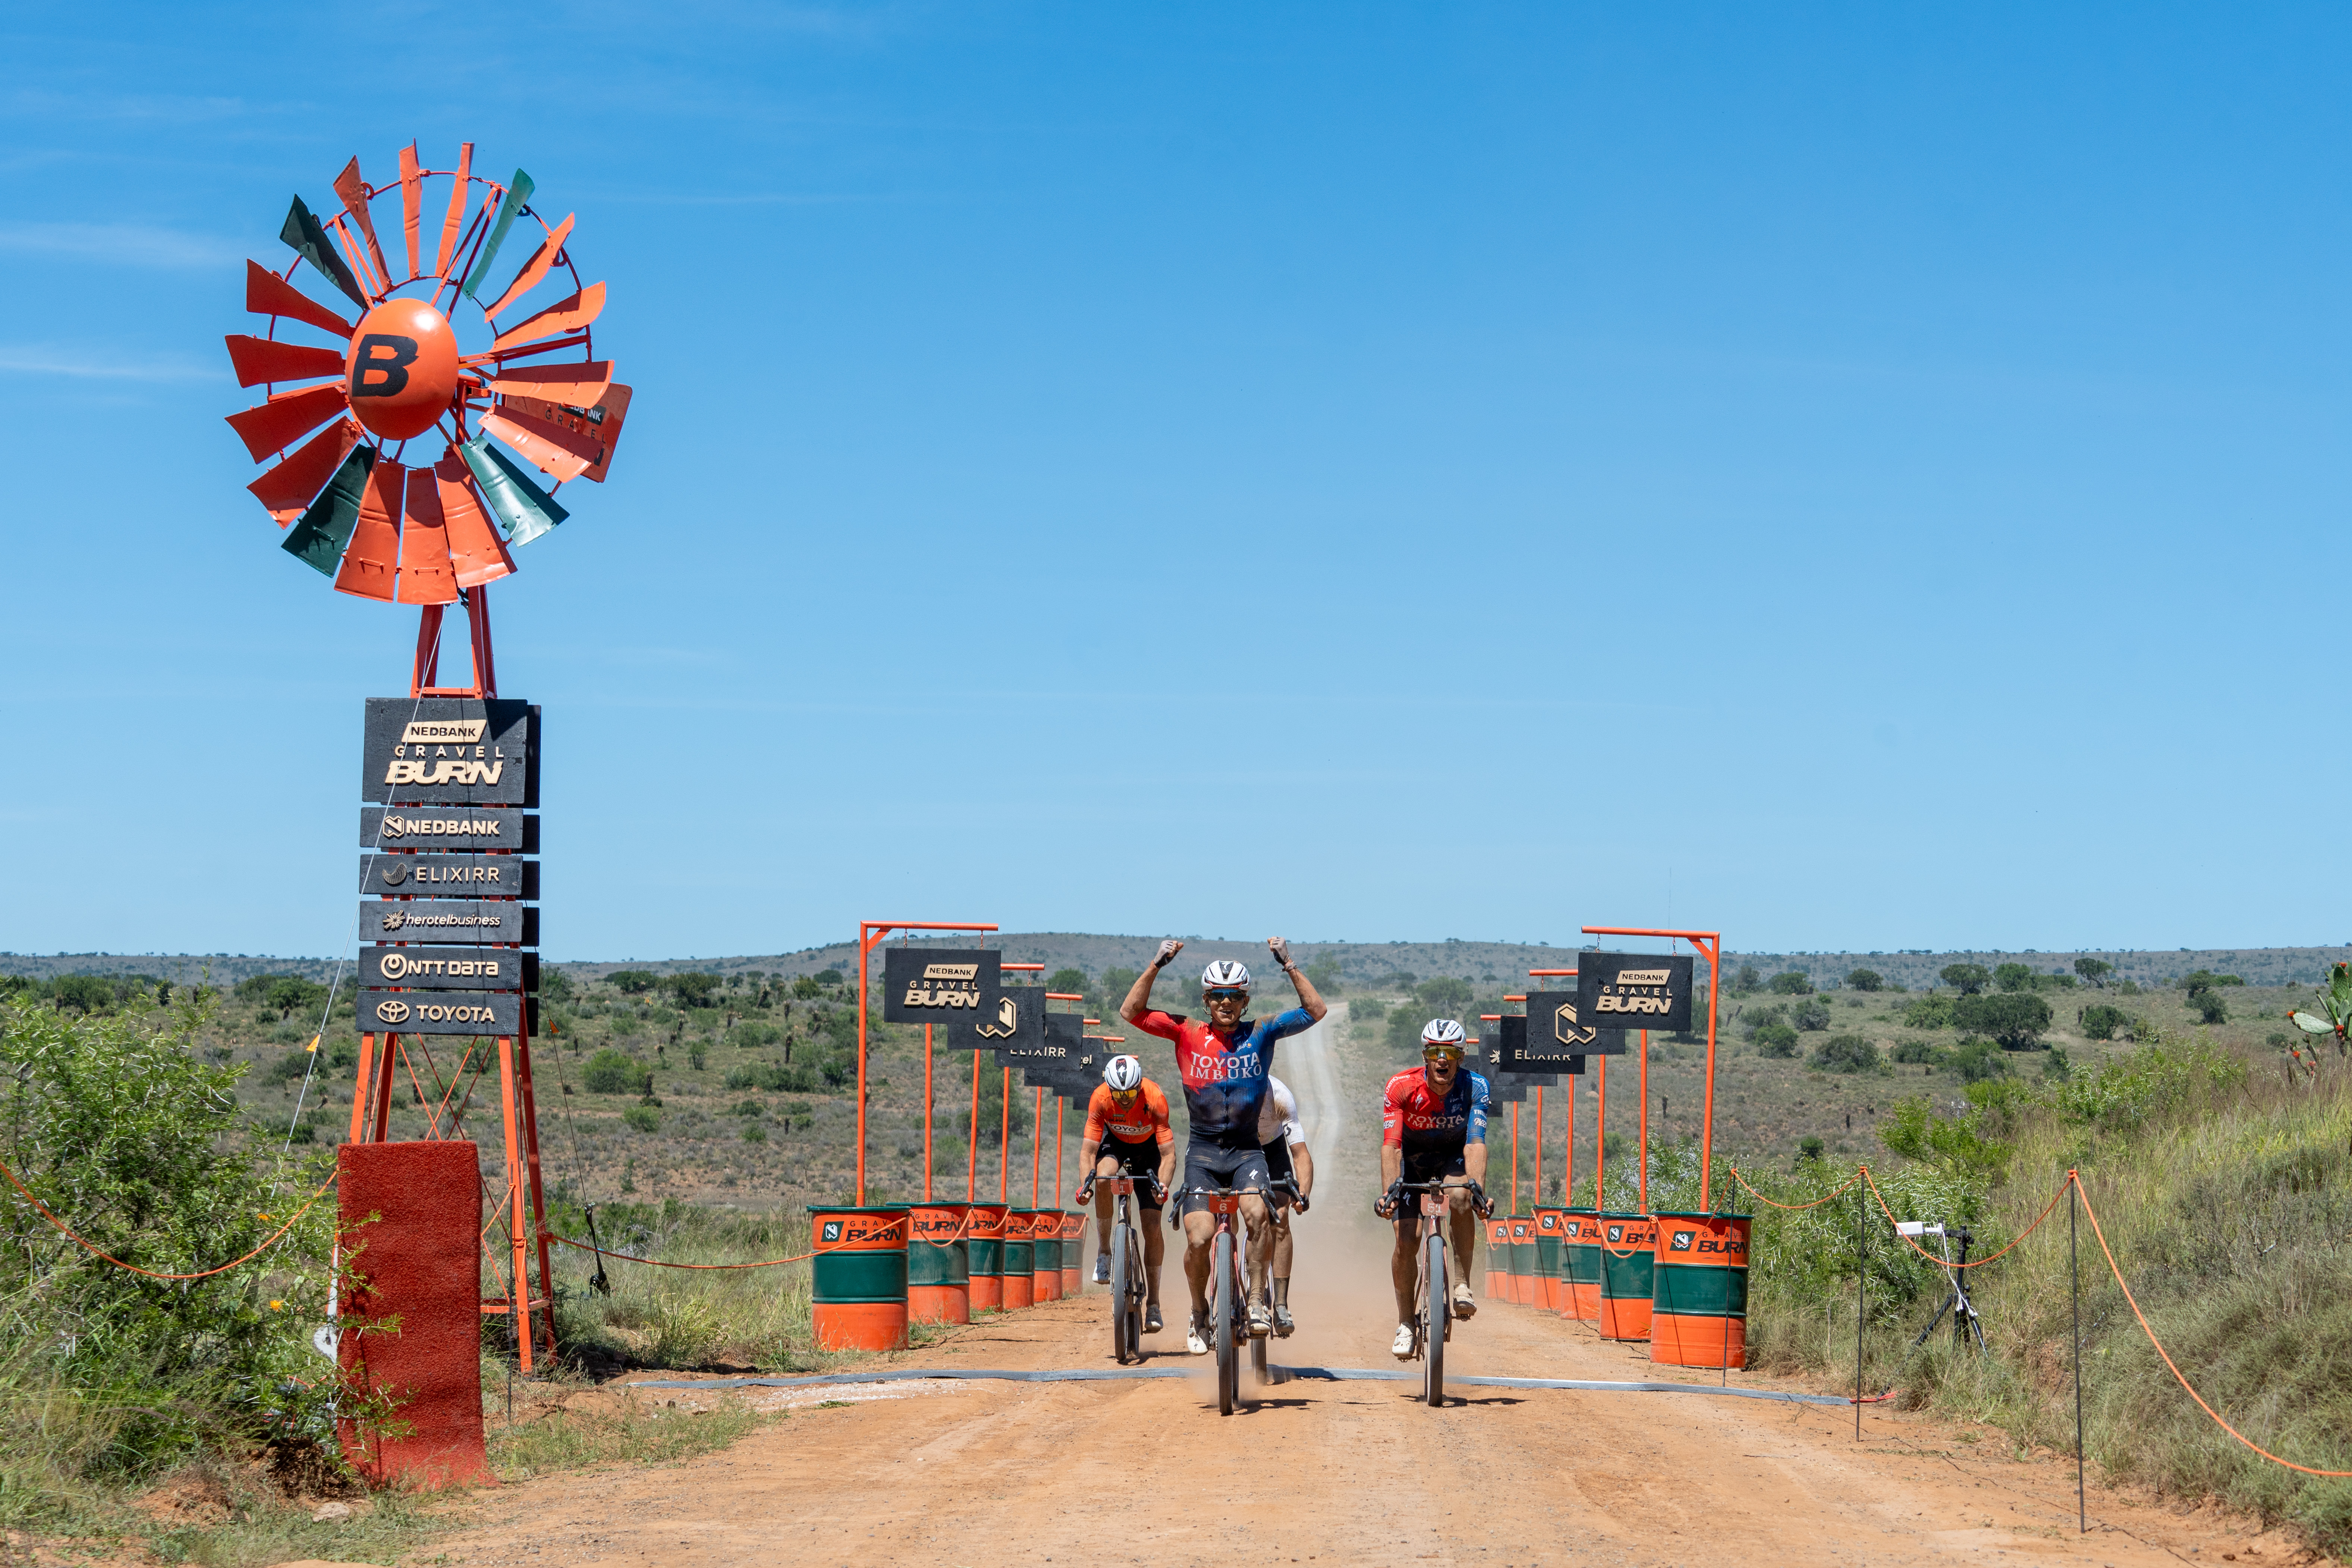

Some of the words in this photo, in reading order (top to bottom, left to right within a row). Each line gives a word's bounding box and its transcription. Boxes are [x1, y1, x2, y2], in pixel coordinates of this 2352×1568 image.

[352, 333, 419, 398] B
[570, 405, 601, 422] DBNK
[411, 727, 476, 737] NEDBANK
[394, 745, 504, 758] GRAVEL
[384, 761, 503, 784] BURN
[406, 820, 500, 835] NEDBANK
[416, 867, 500, 882] ELIXIRR
[406, 913, 501, 926] herotelbusiness
[408, 960, 445, 975] NTT
[930, 967, 972, 976] NEDBANK
[1622, 973, 1664, 981] NEDBANK
[910, 980, 978, 991] GRAVEL
[1603, 986, 1672, 996] GRAVEL
[904, 990, 981, 1008] BURN
[1595, 996, 1672, 1014] BURN
[416, 1005, 495, 1022] TOYOTA
[1191, 1051, 1260, 1069] TOYOTA
[1189, 1064, 1262, 1080] IMBUKO
[1385, 1074, 1410, 1093] ChemChamp
[1407, 1117, 1455, 1129] IMBUK
[1409, 1112, 1465, 1125] TOYOTA
[1219, 1203, 1227, 1212] 6
[1427, 1203, 1442, 1213] 51
[913, 1221, 960, 1232] BURN
[968, 1220, 998, 1230] URN
[1006, 1225, 1029, 1234] RN
[1035, 1224, 1053, 1232] RN
[845, 1228, 902, 1242] BURN
[1581, 1228, 1601, 1238] BU
[1697, 1240, 1748, 1254] BURN
